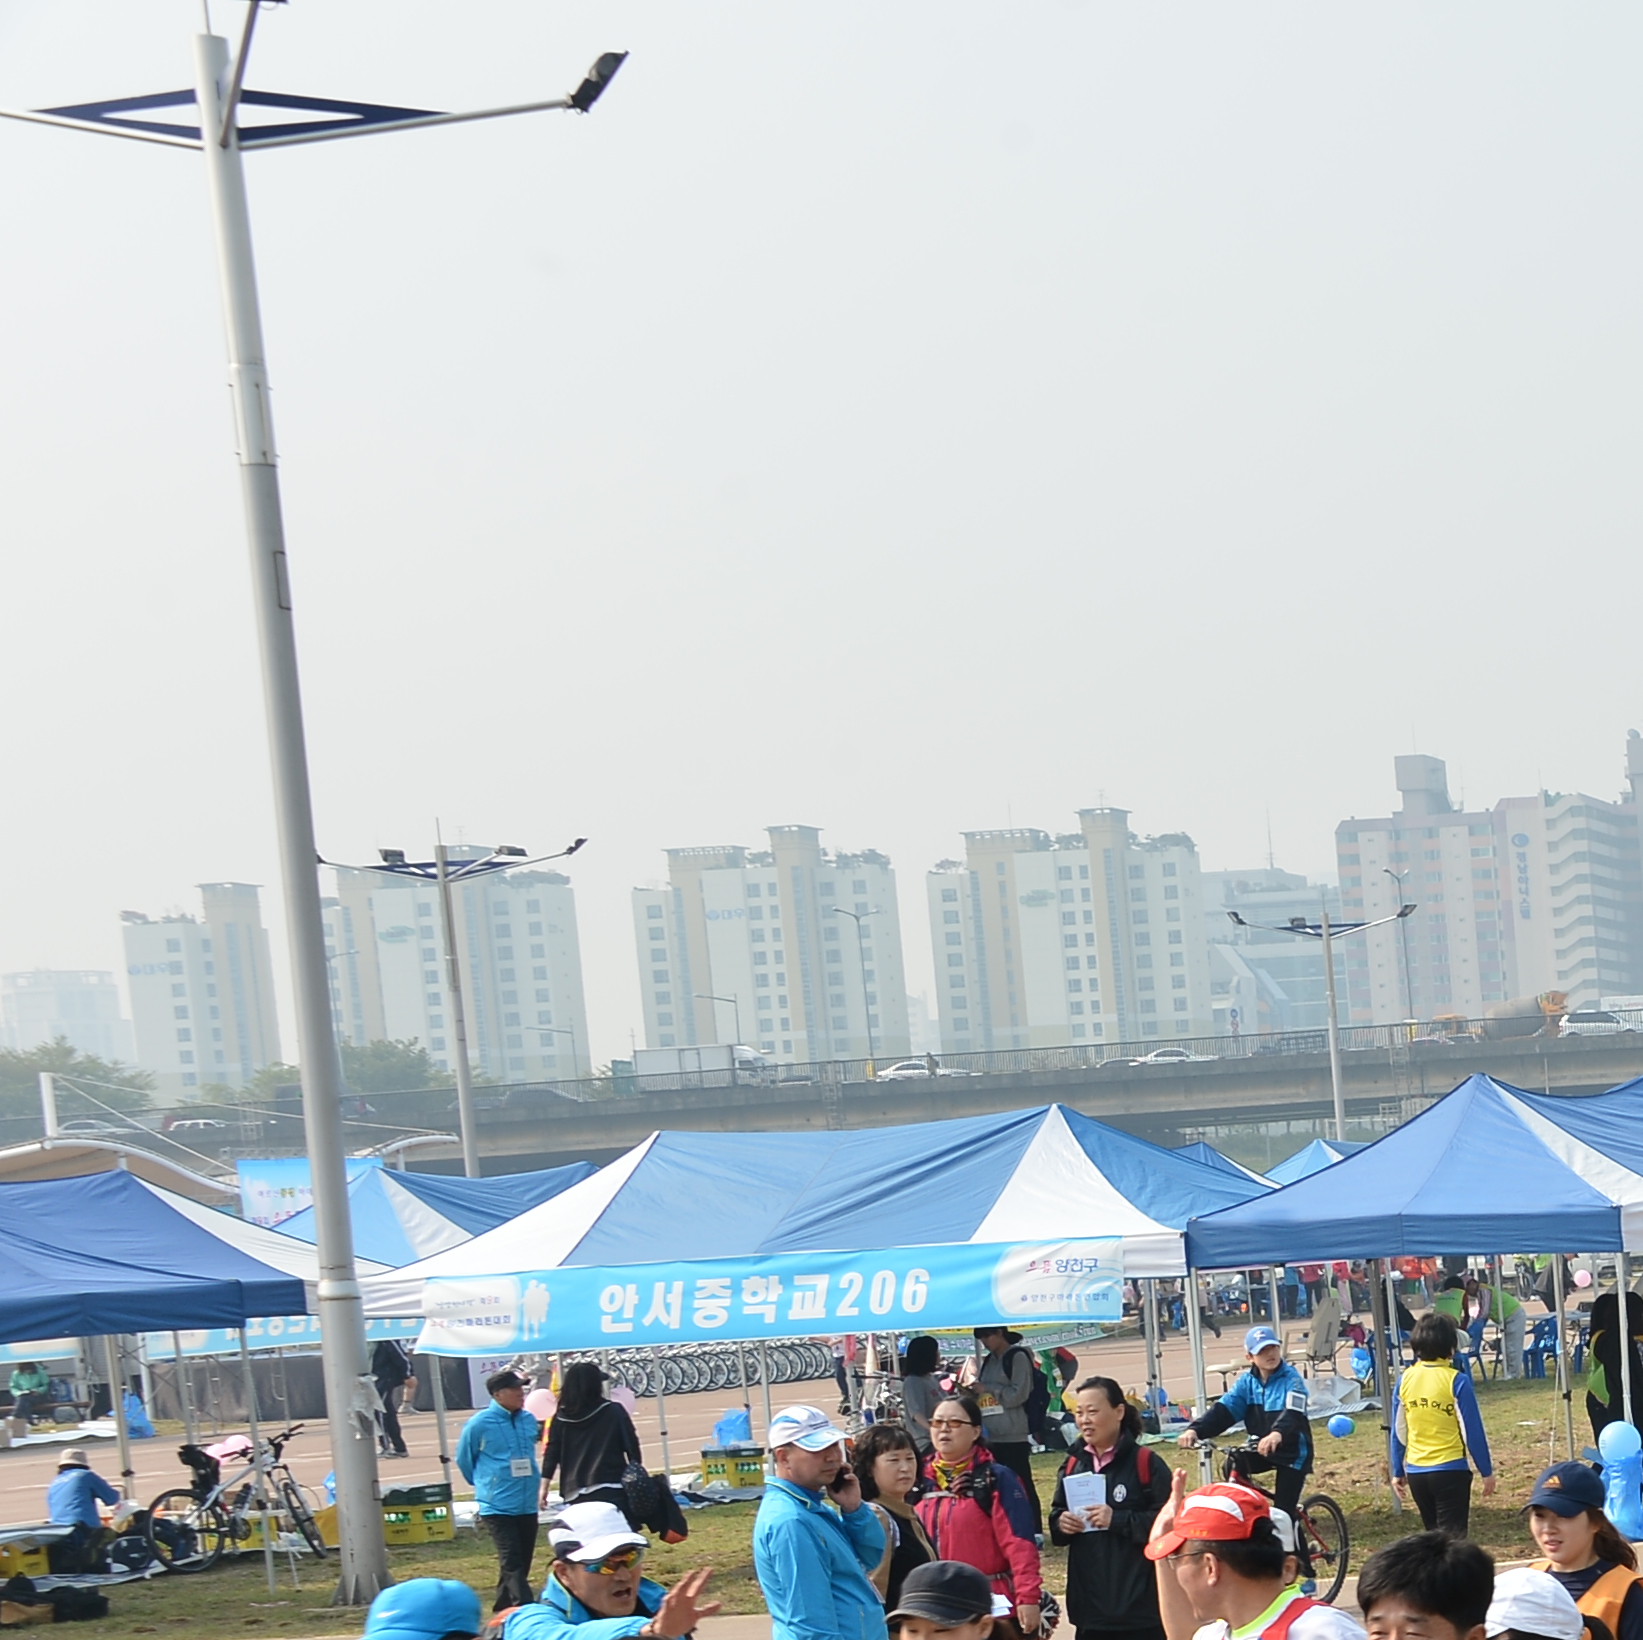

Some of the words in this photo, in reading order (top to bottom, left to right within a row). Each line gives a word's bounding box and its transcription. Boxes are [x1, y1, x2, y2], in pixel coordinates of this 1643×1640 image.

[1025, 1259, 1050, 1274] 으뜸
[1055, 1257, 1099, 1273] 양천구
[598, 1268, 931, 1334] 안서중학교206
